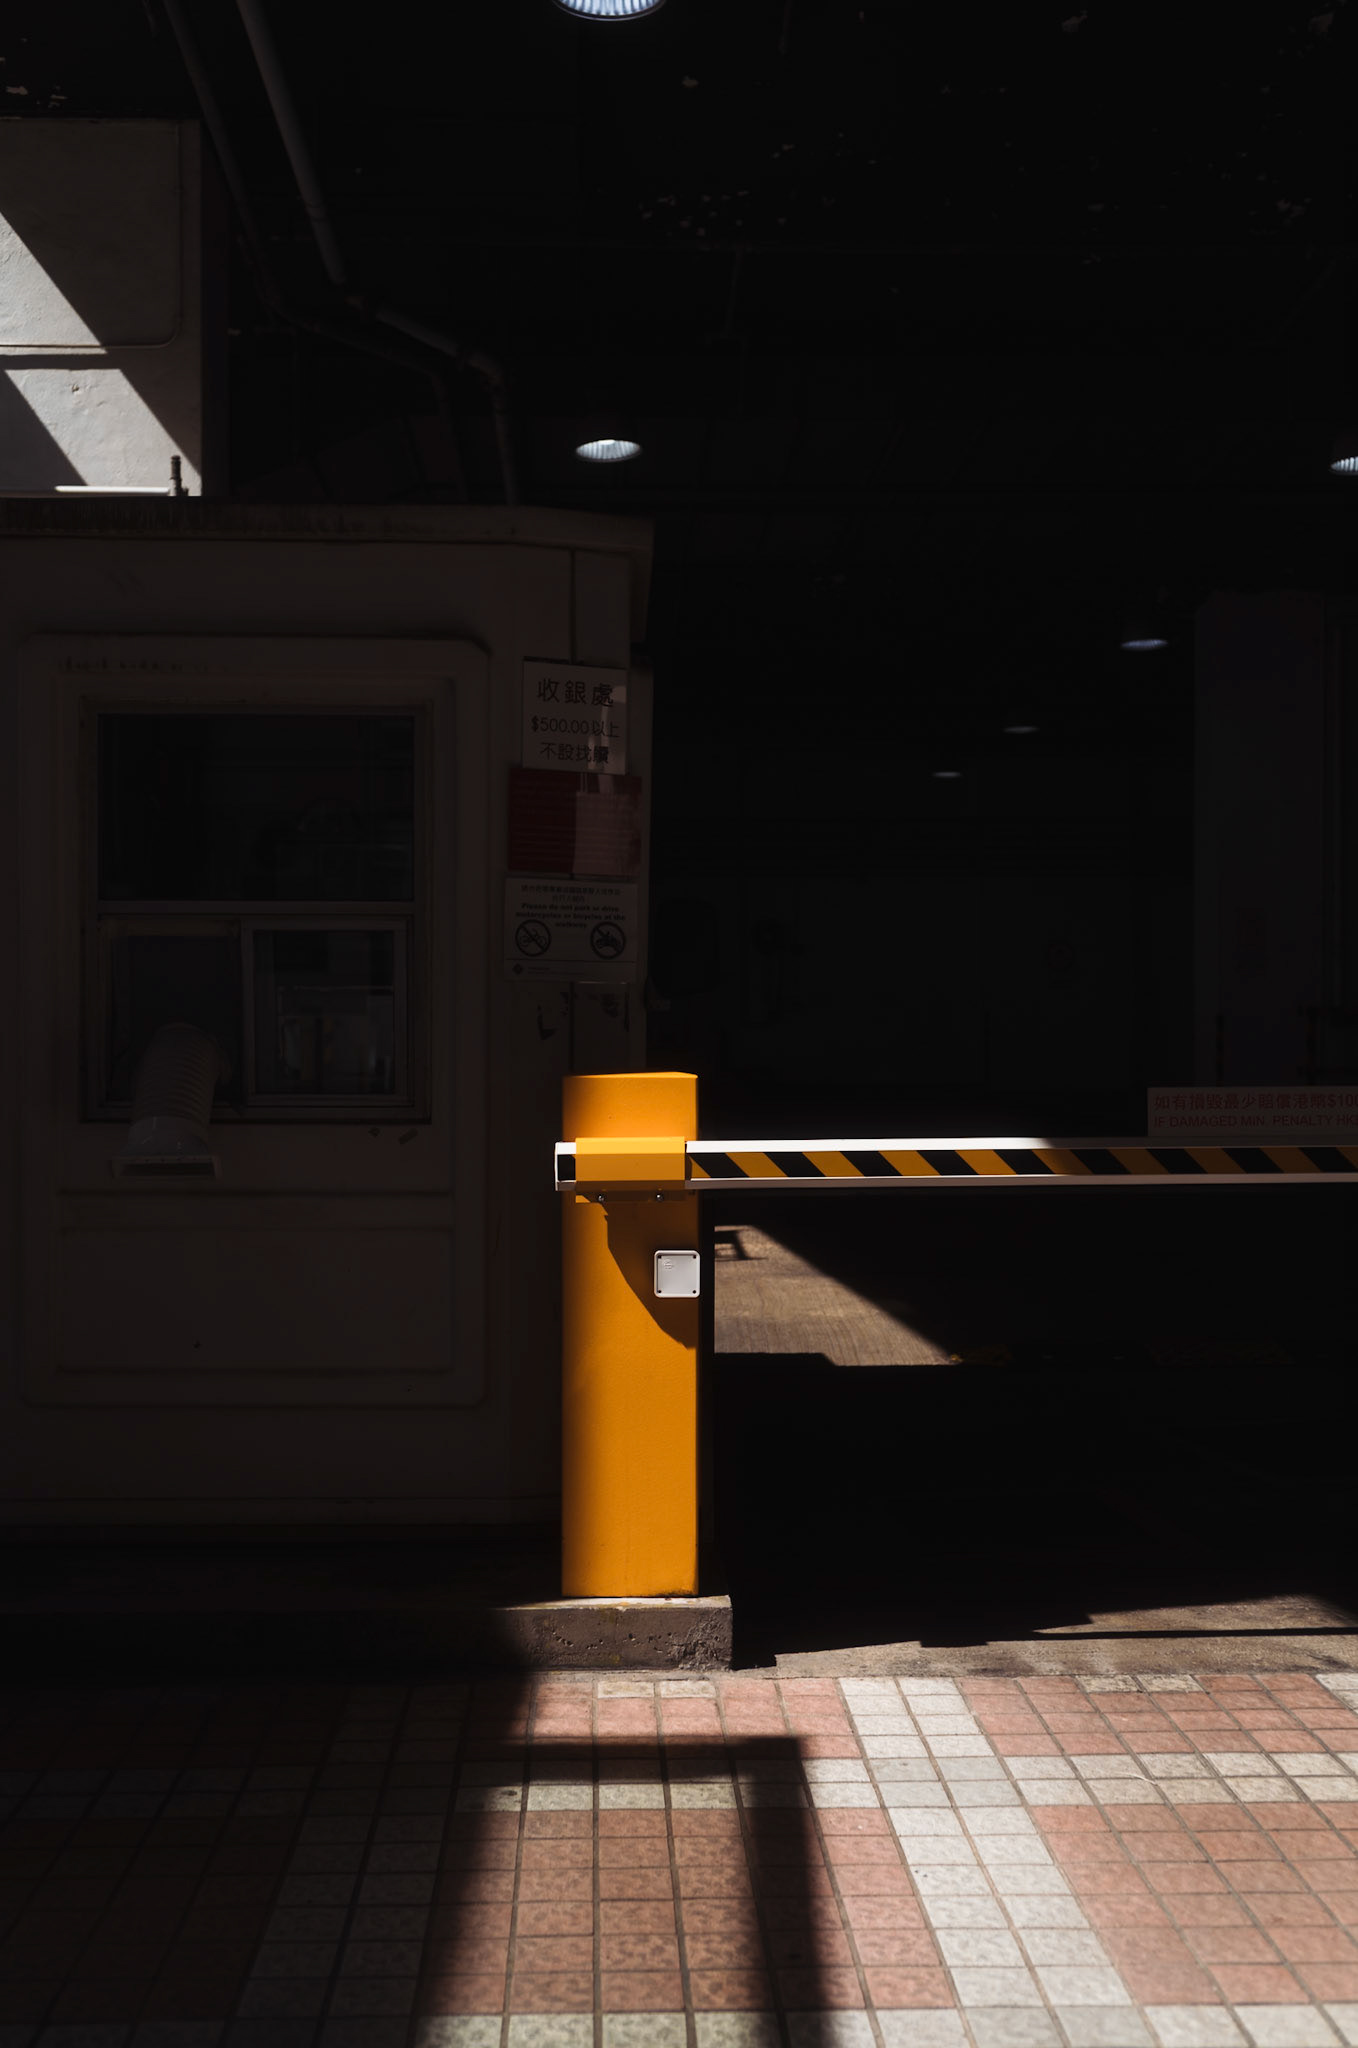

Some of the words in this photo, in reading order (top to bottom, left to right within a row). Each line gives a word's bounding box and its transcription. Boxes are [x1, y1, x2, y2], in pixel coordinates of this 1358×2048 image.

[537, 678, 614, 707] 收銀處
[531, 715, 620, 738] $500.00以上
[1154, 1115, 1167, 1127] IF
[1169, 1115, 1237, 1127] DAMAGED
[1273, 1114, 1333, 1126] PENALTY
